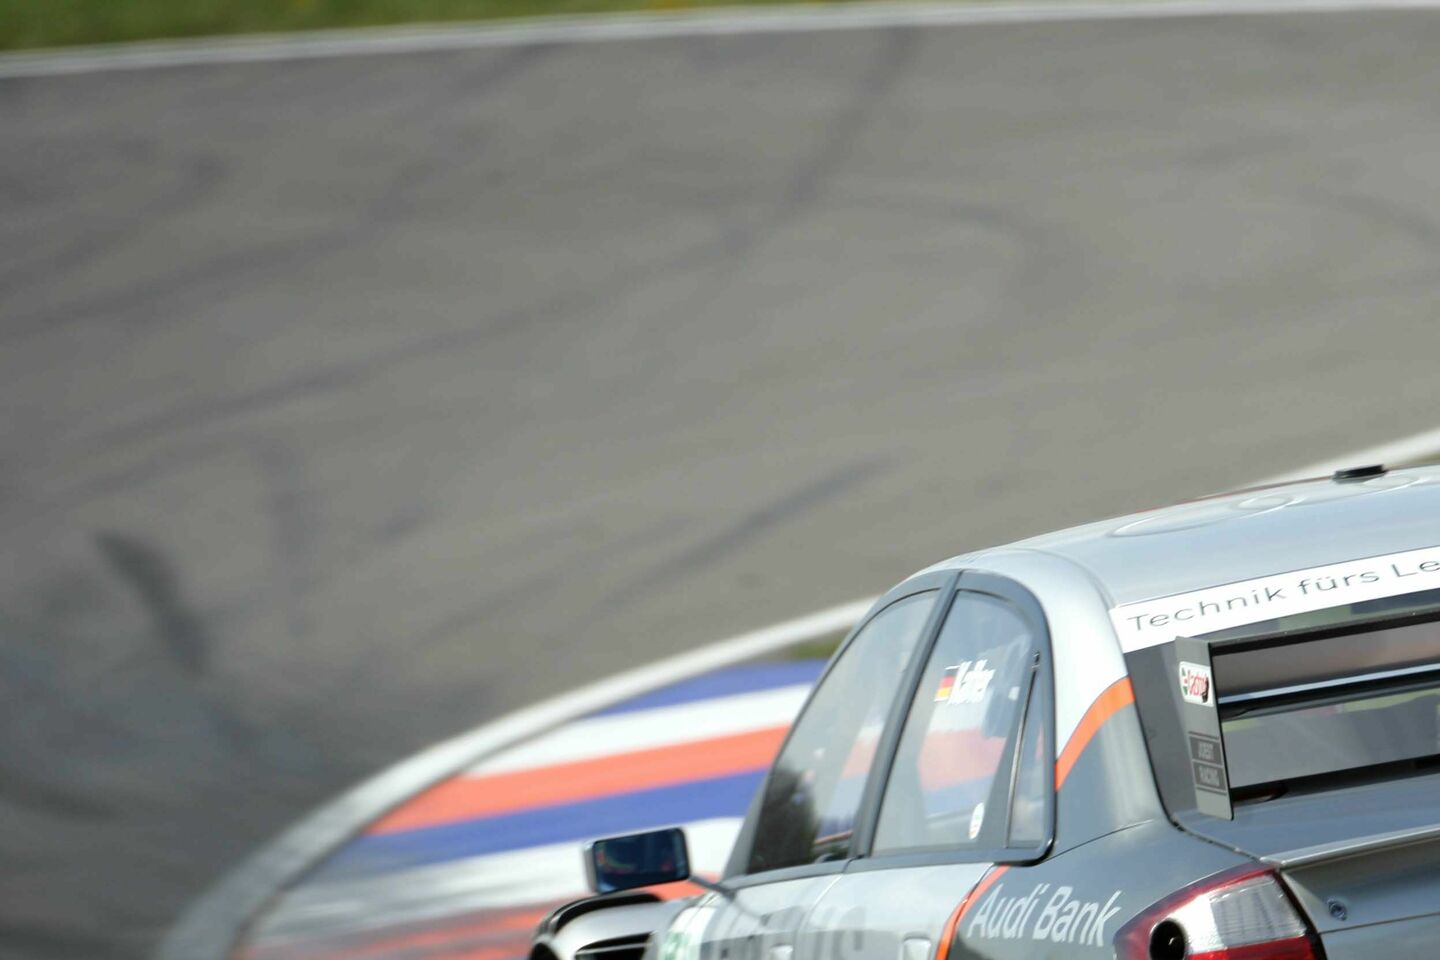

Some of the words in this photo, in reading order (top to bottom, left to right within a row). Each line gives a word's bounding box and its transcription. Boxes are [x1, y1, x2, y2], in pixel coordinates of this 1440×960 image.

[1127, 586, 1286, 631] Technik
[1297, 570, 1380, 595] fürs
[967, 883, 1051, 940] Audi
[1032, 885, 1122, 947] Bank
